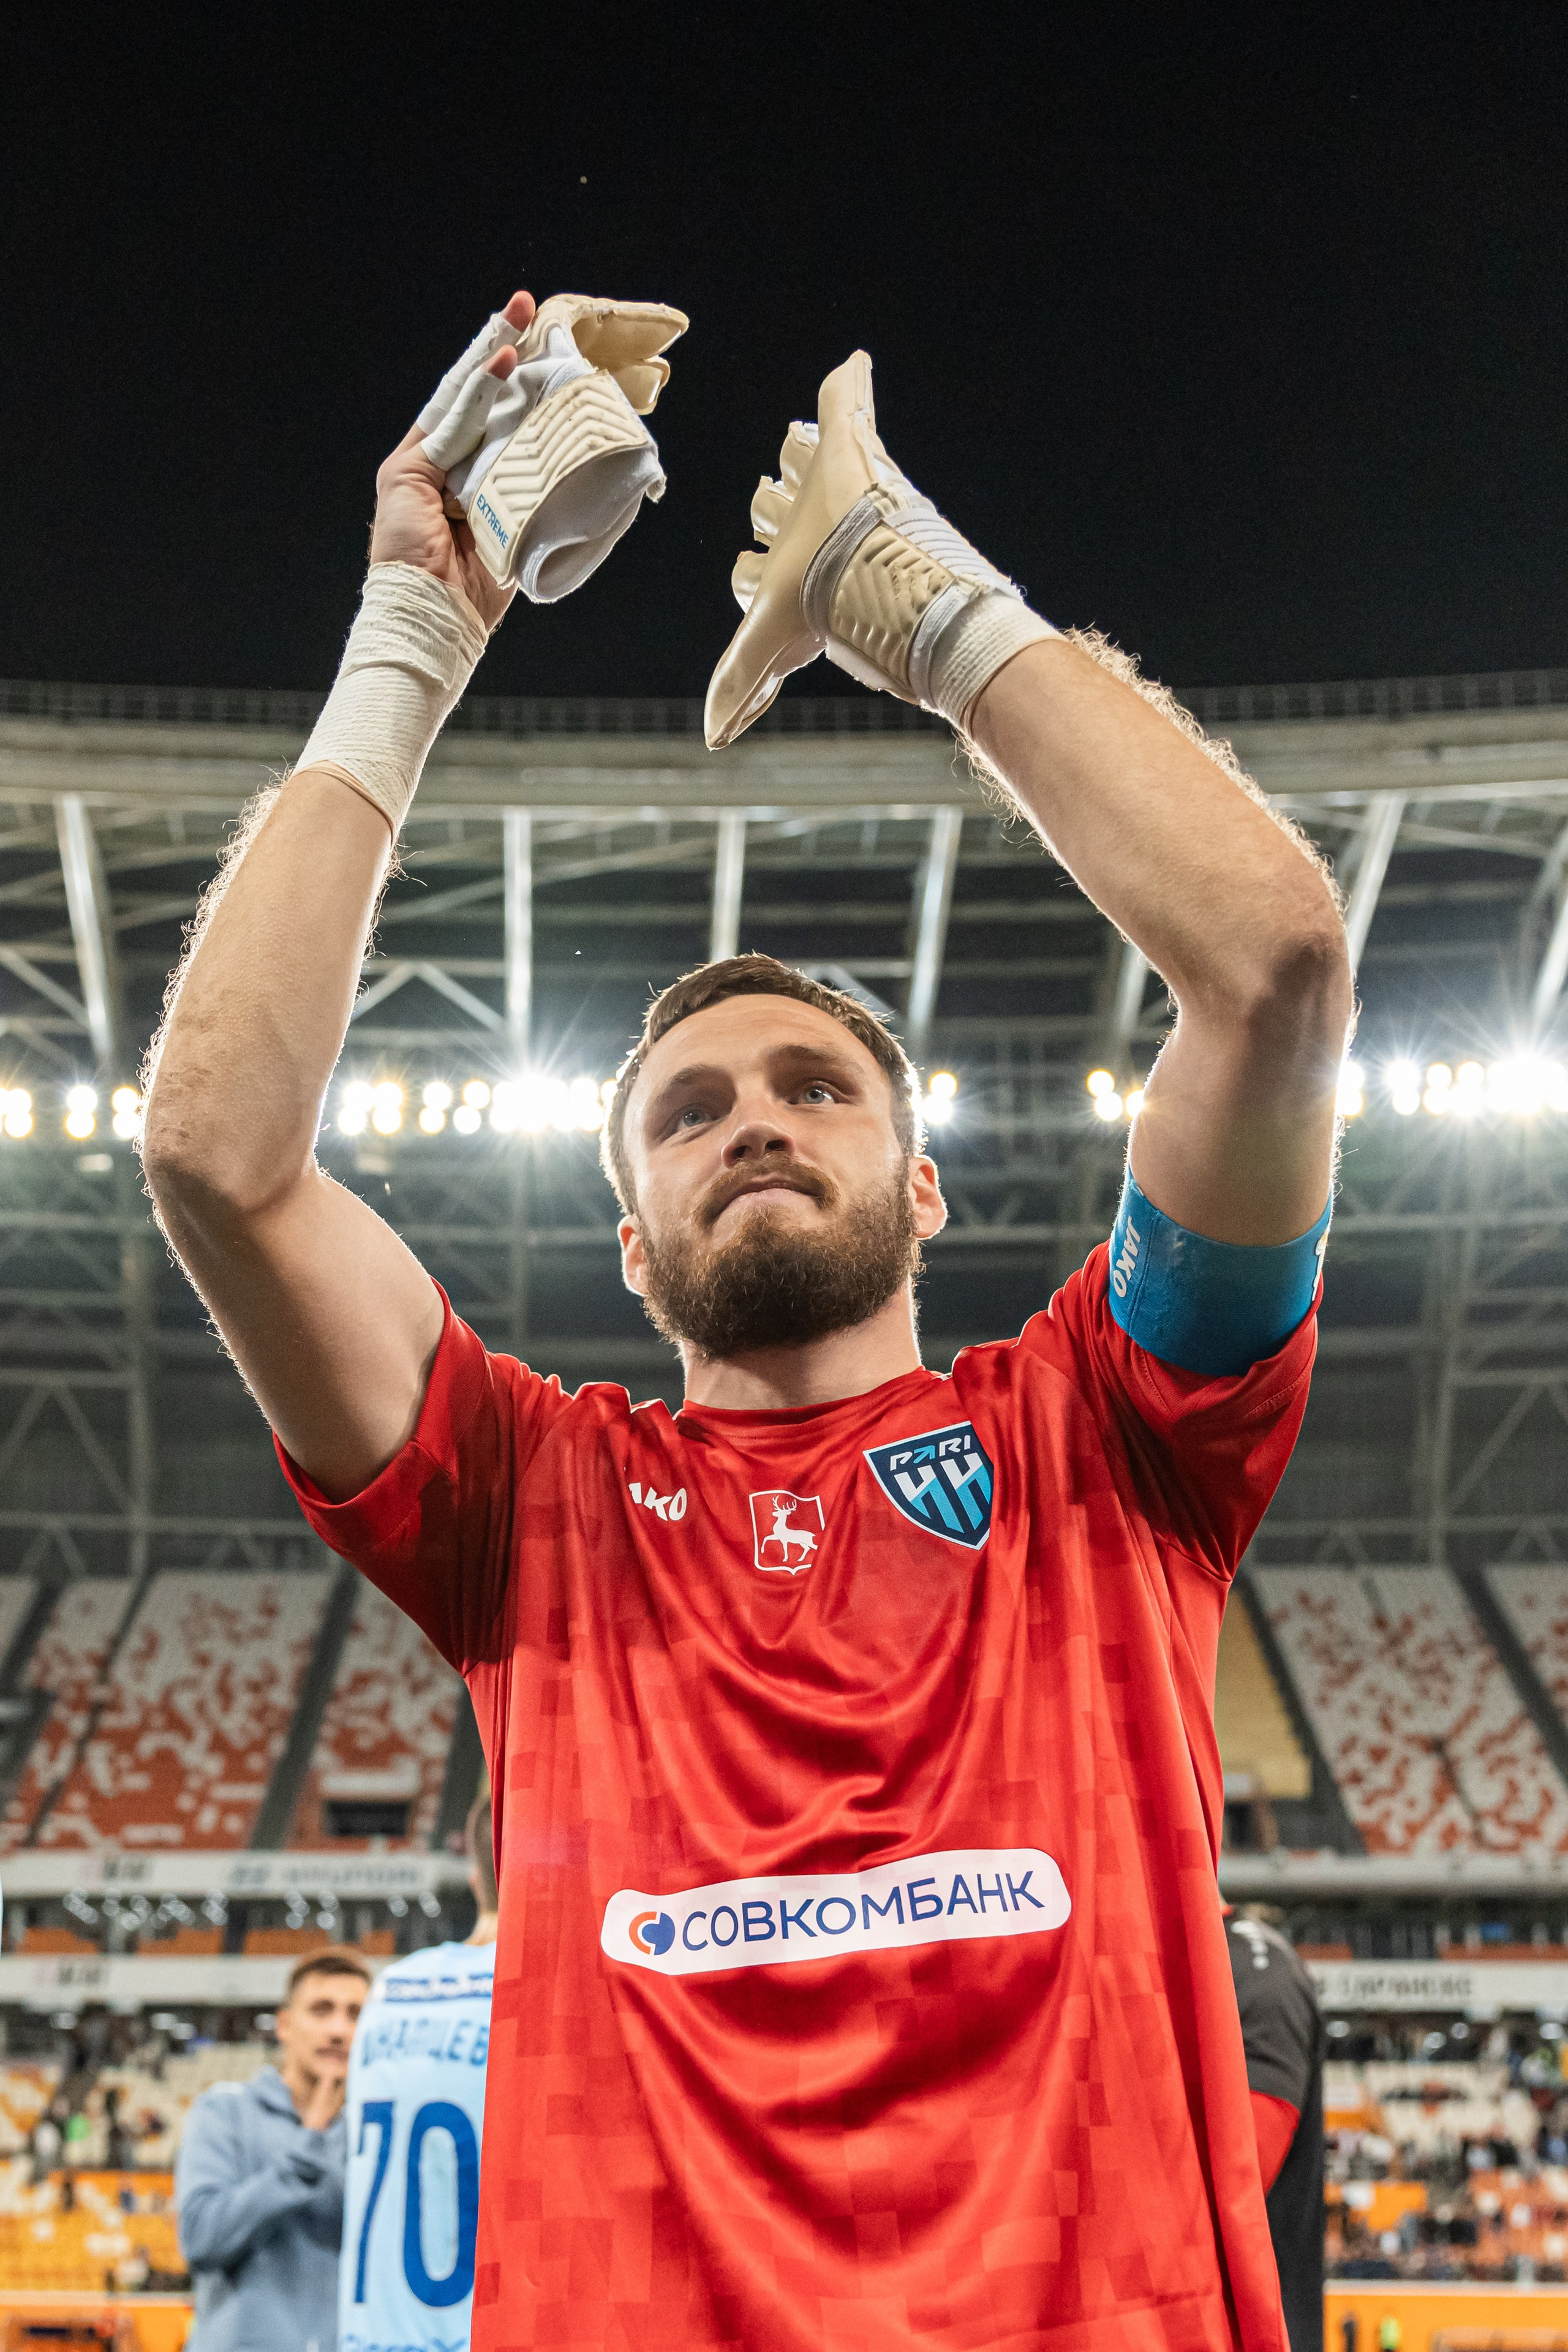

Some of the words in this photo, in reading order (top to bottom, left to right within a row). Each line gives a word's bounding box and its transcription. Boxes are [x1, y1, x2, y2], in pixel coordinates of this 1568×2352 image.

[477, 493, 509, 549] EXTREME
[1113, 1216, 1141, 1298] JAKO
[682, 1870, 1046, 1952] СОВКОМБАНК
[353, 2100, 480, 2308] 70
